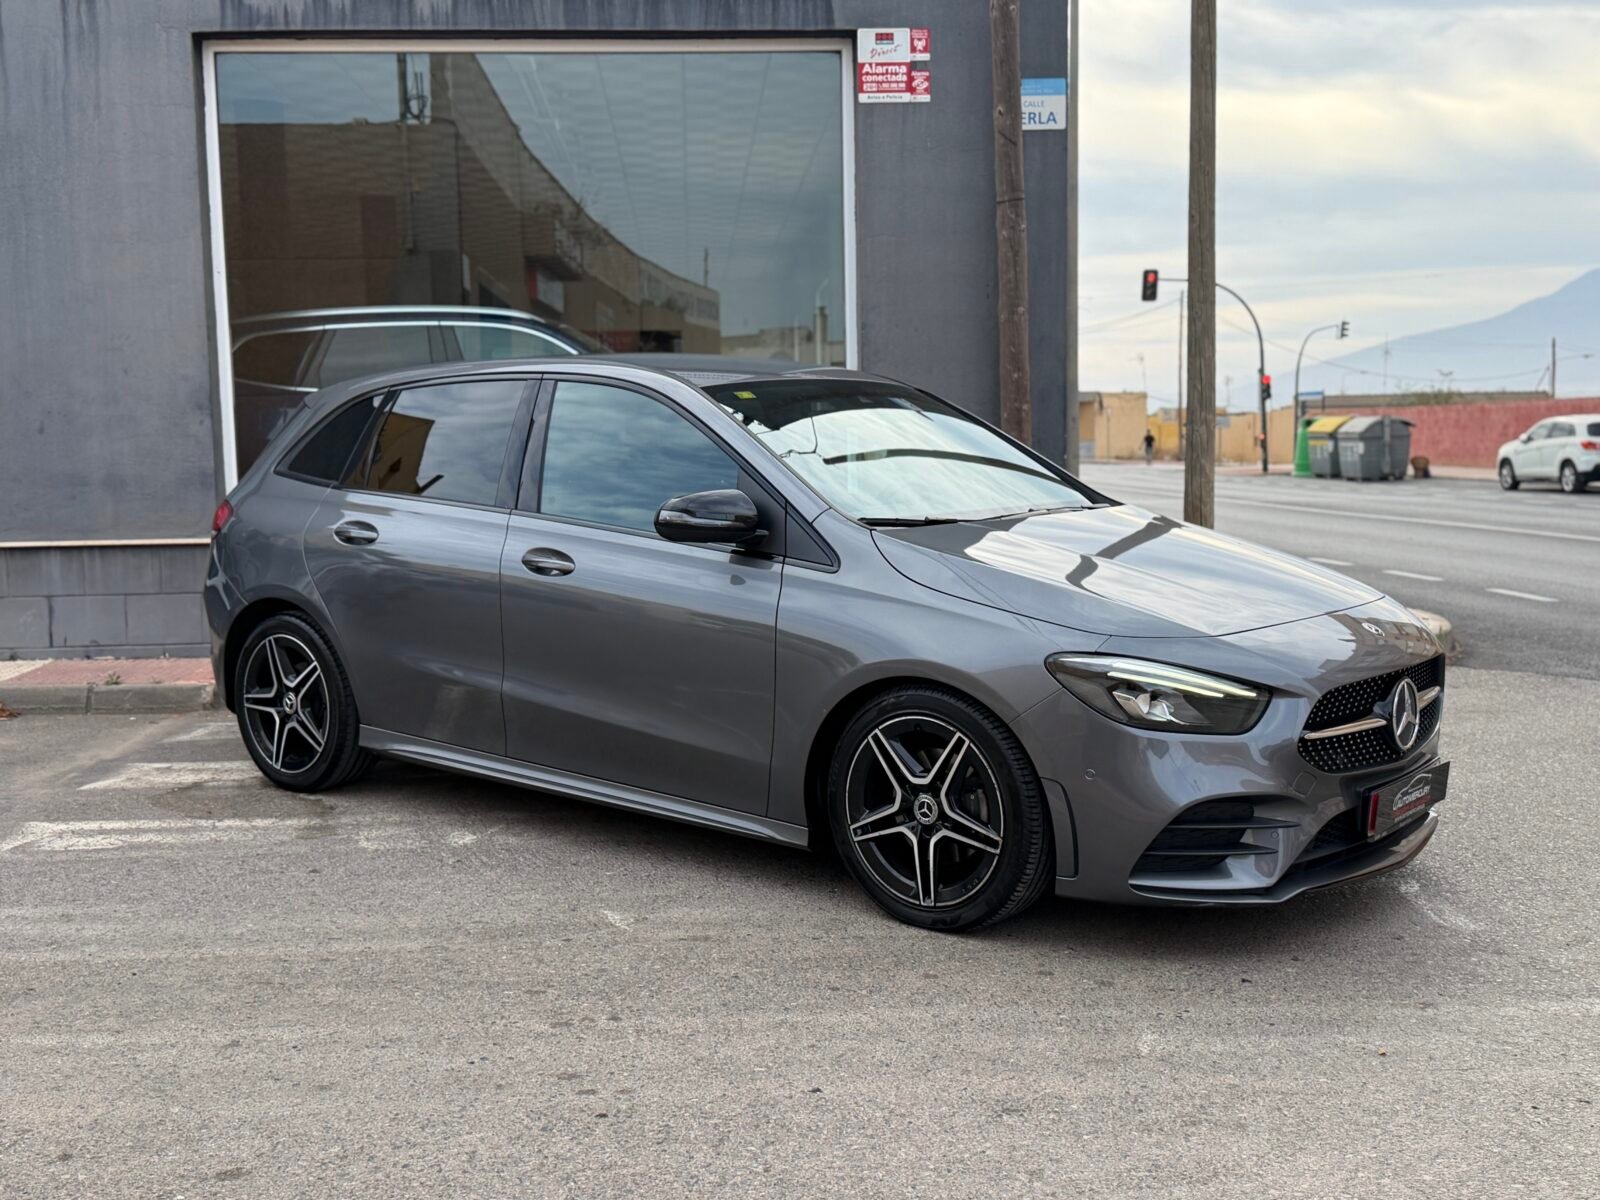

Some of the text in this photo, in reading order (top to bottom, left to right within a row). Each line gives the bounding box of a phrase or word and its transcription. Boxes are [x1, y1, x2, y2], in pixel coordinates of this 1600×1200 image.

[862, 63, 907, 73] Alarma
[862, 73, 908, 82] conectada
[1023, 100, 1045, 108] CALLE
